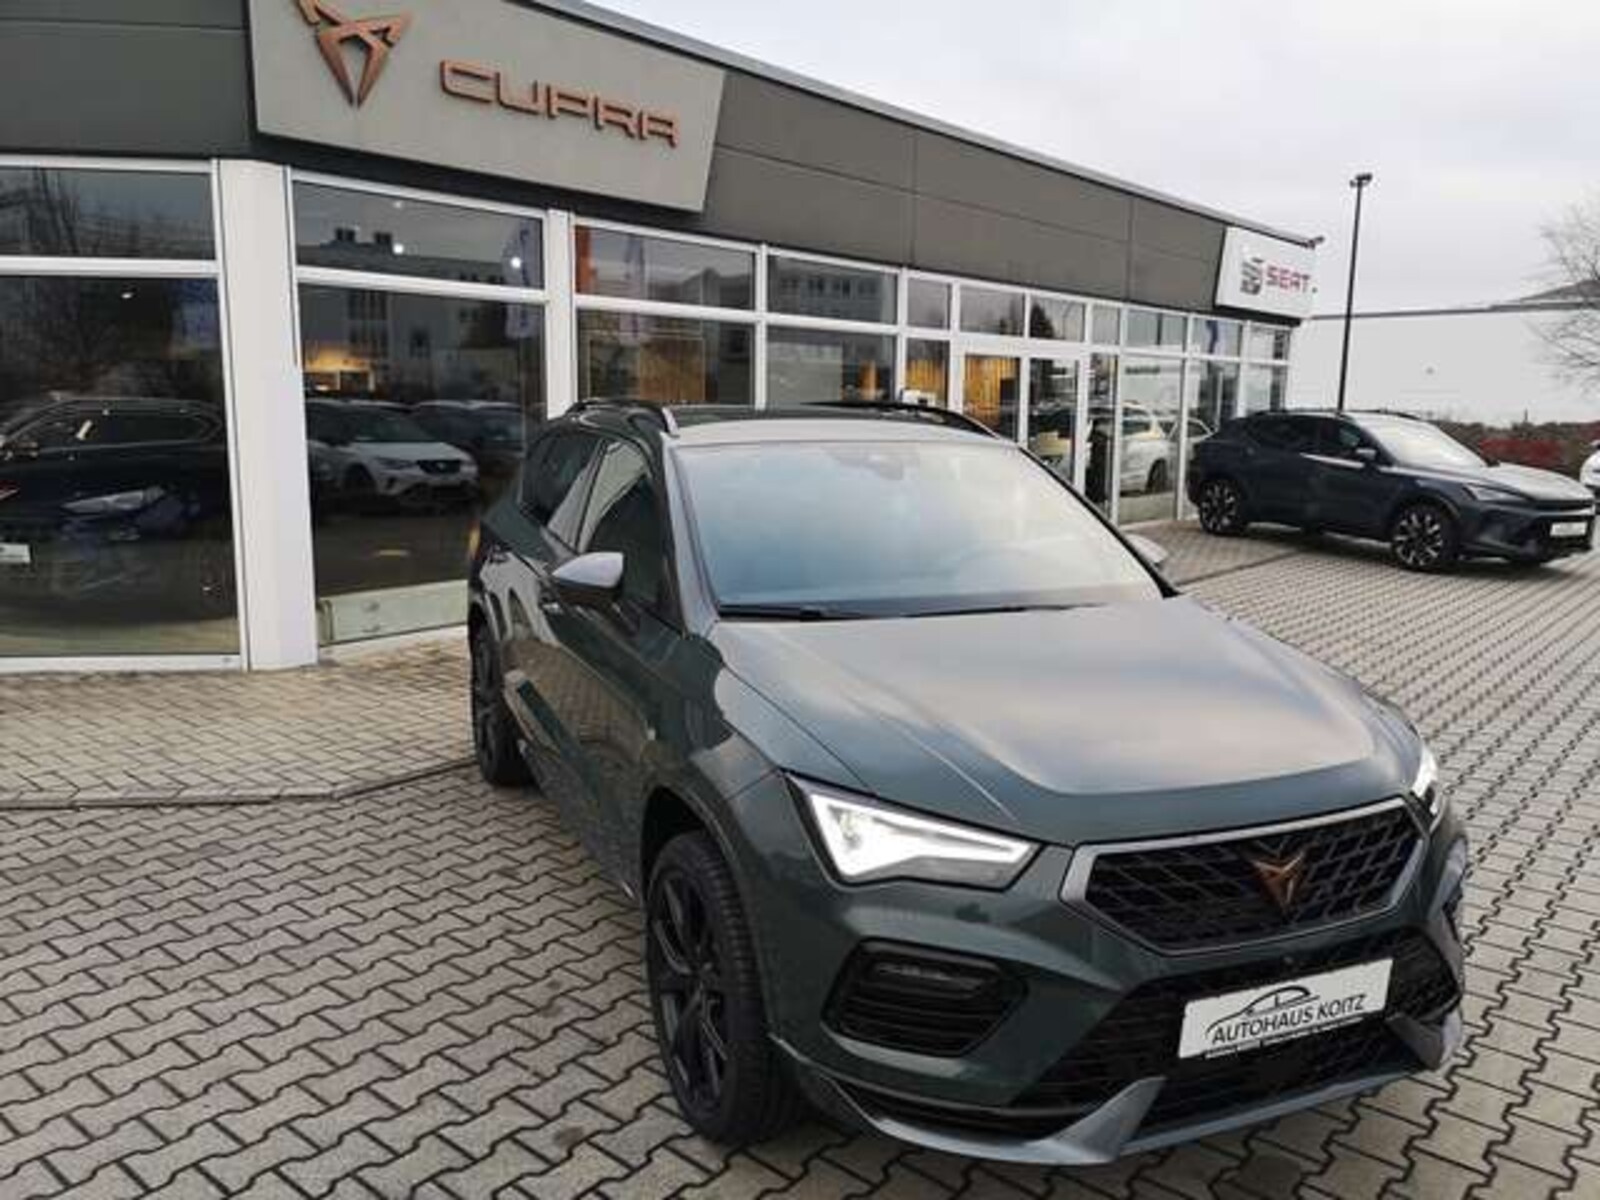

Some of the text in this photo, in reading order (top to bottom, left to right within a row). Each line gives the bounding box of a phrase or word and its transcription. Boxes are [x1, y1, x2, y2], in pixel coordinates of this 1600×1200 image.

[440, 59, 678, 148] CUPRA
[1266, 264, 1310, 293] SEAT
[1211, 993, 1367, 1044] AUTOHAUS KOITZ
